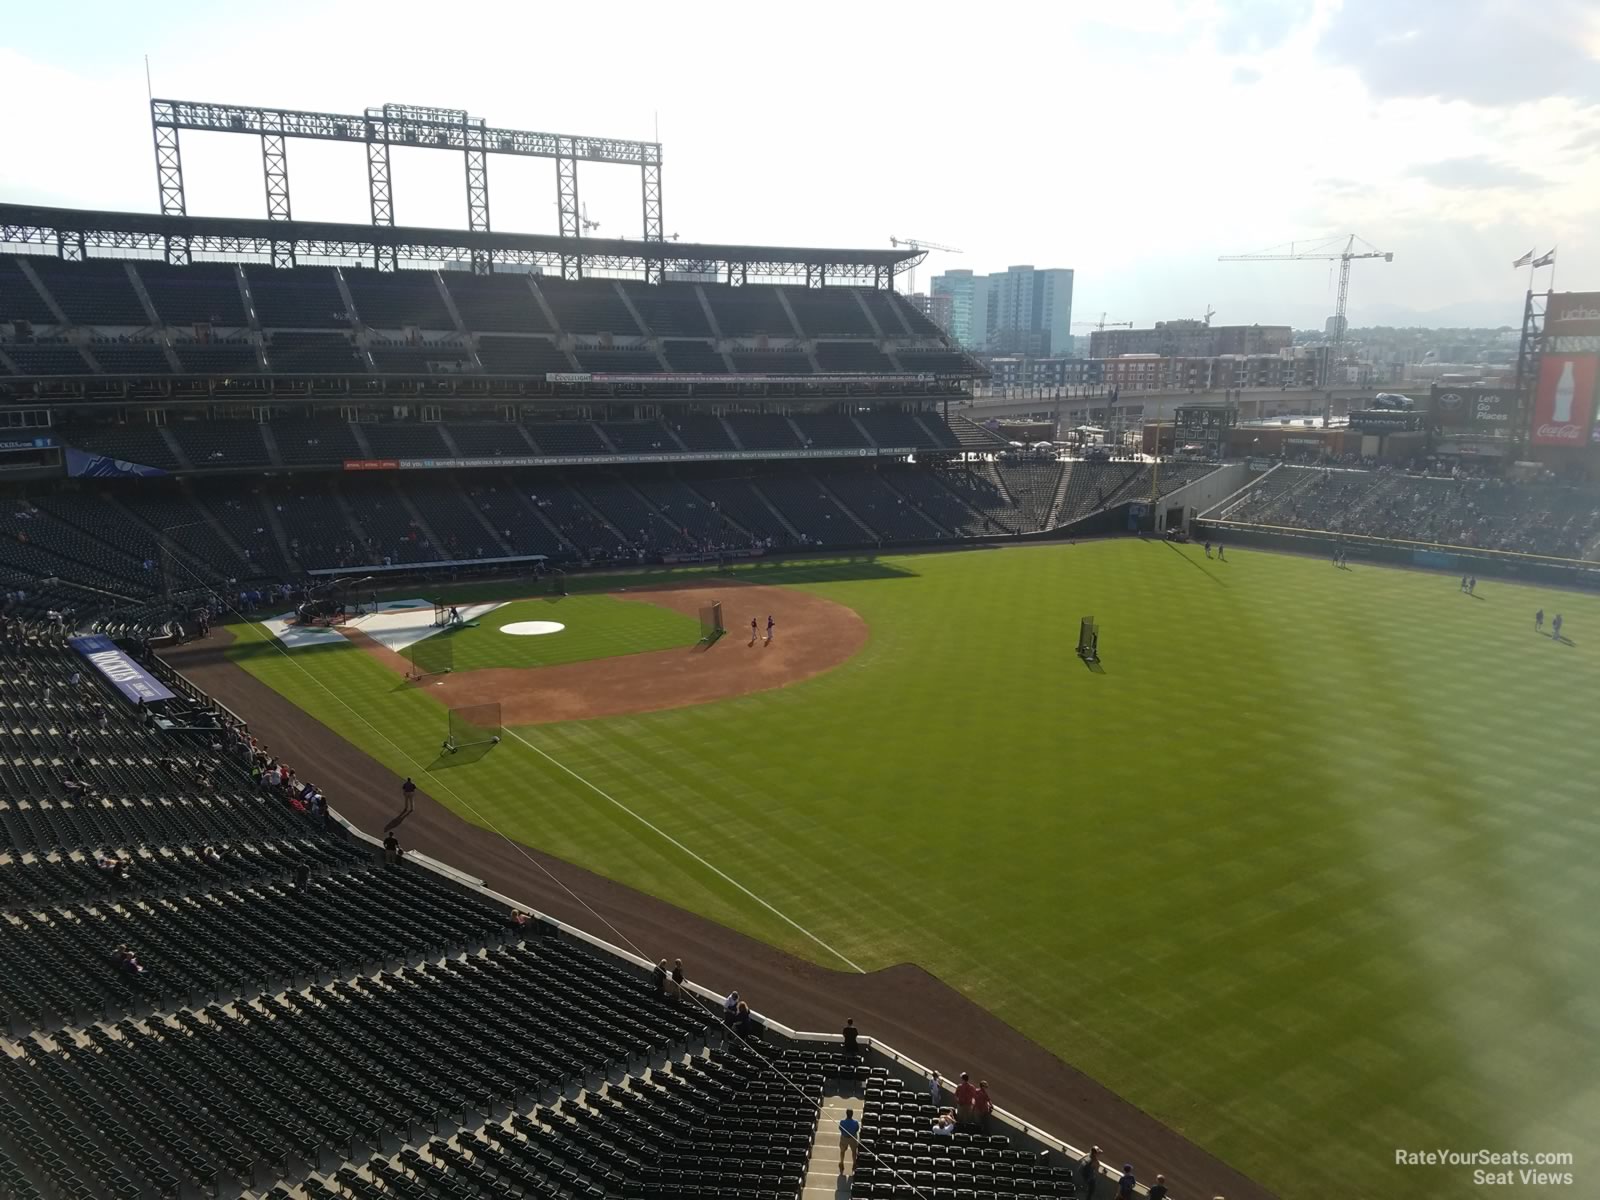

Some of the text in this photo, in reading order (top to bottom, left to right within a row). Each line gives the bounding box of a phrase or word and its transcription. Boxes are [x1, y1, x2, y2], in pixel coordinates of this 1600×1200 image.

[1479, 395, 1501, 403] Let's
[1477, 403, 1491, 411] Go
[1476, 412, 1508, 420] Places
[1536, 424, 1583, 438] Coca-Cola
[89, 650, 144, 682] ROCKIES
